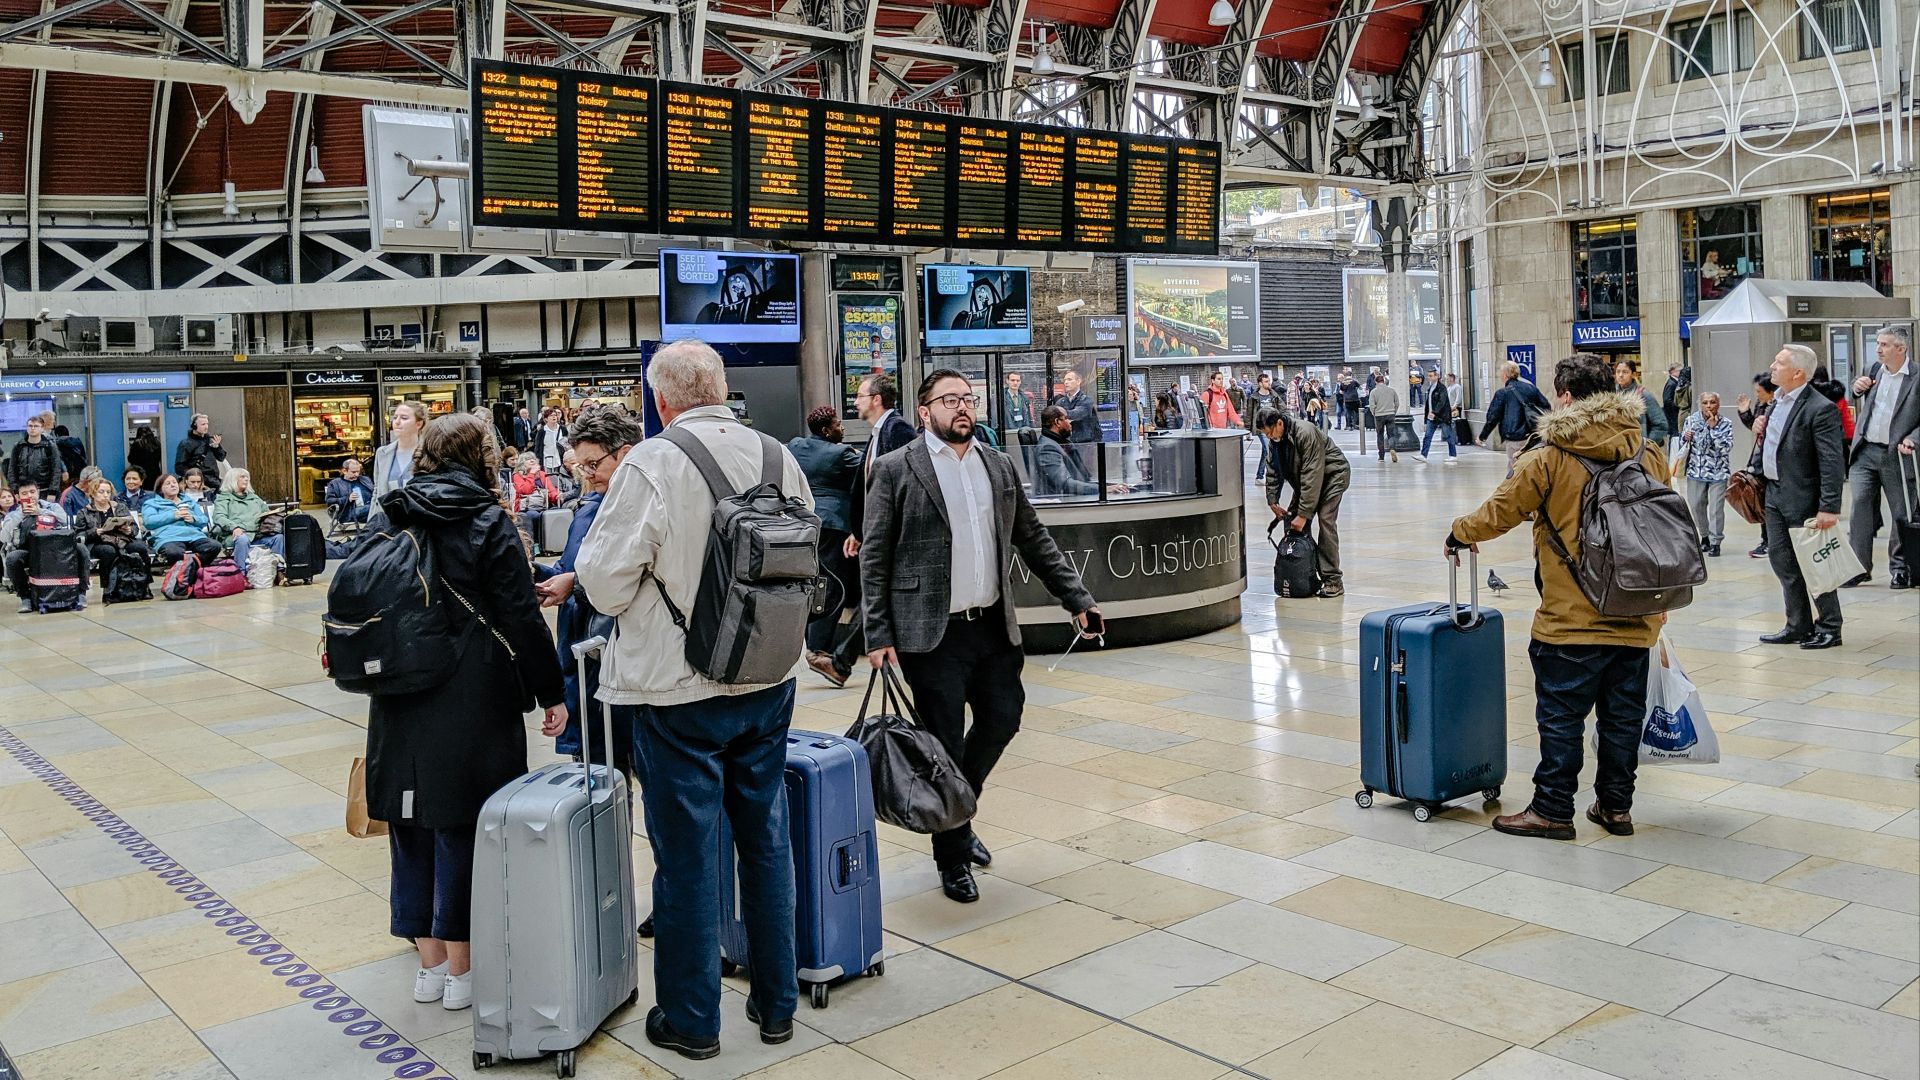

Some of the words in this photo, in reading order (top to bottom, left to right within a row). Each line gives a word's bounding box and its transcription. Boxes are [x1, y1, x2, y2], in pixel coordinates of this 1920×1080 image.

[482, 73, 507, 83] 13:22
[520, 76, 557, 90] Boarding
[578, 84, 600, 93] 13:27
[613, 87, 647, 100] Boarding
[577, 96, 608, 107] Cholsey
[669, 93, 689, 103] 13:30
[696, 96, 732, 109] Preparing
[668, 105, 693, 115] Bristol
[704, 109, 726, 119] Meads
[750, 103, 770, 112] 13:33
[499, 119, 532, 128] Charlbury
[750, 114, 782, 125] Heathrow
[785, 118, 801, 127] T234
[825, 122, 860, 133] Cheltenham
[862, 127, 874, 135] Spa
[896, 130, 920, 139] Twyford
[680, 255, 695, 263] SEE
[698, 255, 706, 263] IT.
[698, 264, 706, 272] IT.
[680, 272, 717, 280] SORTED.
[844, 311, 894, 326] escape
[1090, 319, 1121, 330] Paddington
[377, 329, 391, 340] 12
[462, 326, 477, 337] 14
[1096, 332, 1116, 340] Station
[1578, 326, 1636, 340] WHSmith
[847, 338, 870, 349] YOUR
[1509, 351, 1533, 362] WH
[1108, 534, 1240, 579] Customer
[1649, 722, 1681, 740] Together
[1649, 750, 1666, 758] Join
